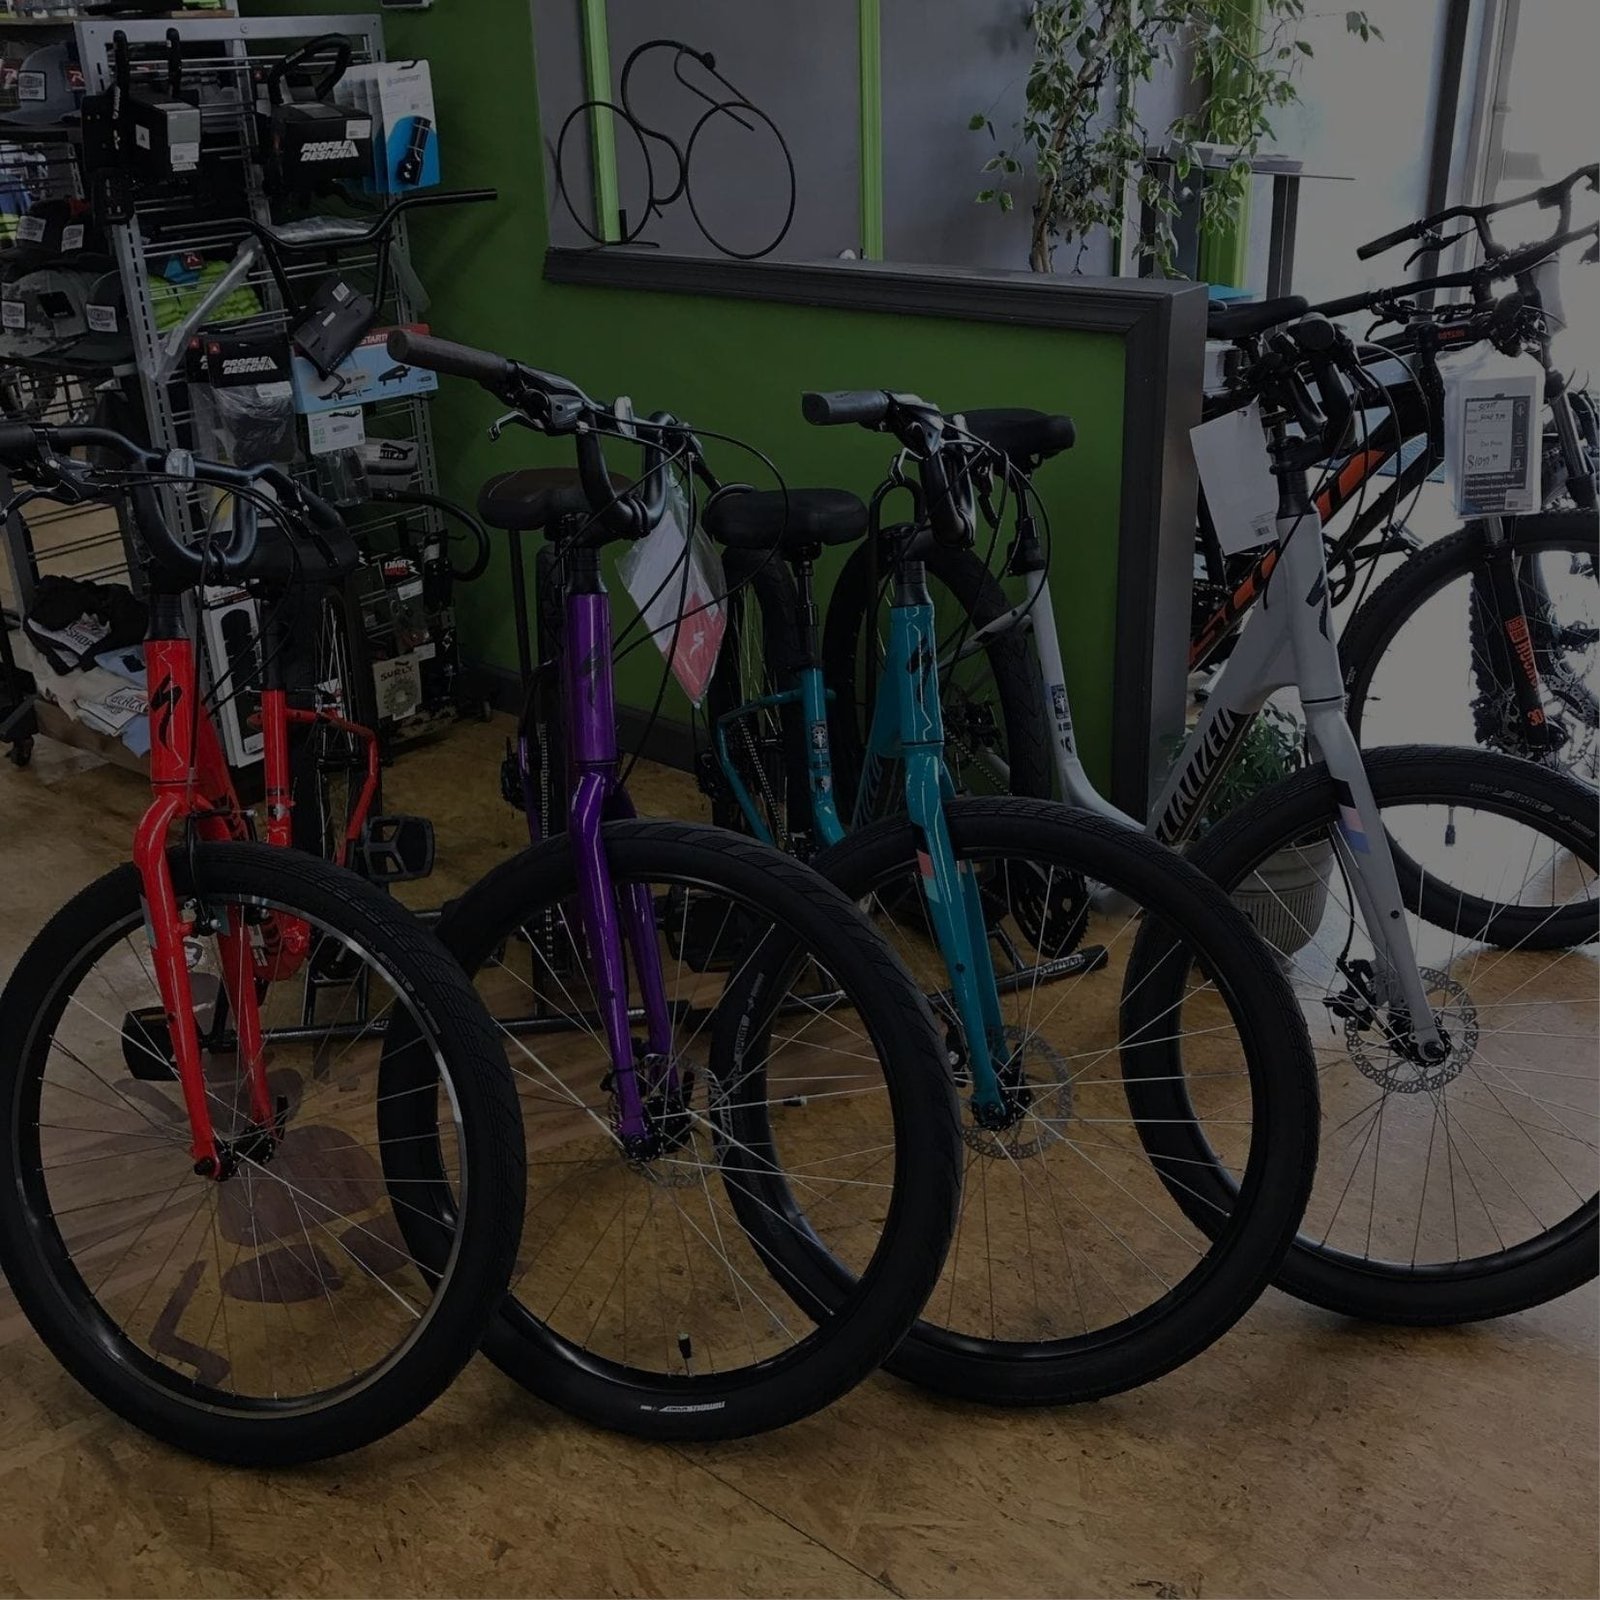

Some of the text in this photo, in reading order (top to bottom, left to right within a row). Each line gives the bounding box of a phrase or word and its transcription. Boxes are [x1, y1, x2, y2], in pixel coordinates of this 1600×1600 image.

[300, 140, 351, 153] PROFILE
[300, 149, 350, 161] DESIGN
[222, 355, 269, 369] PROFILE
[222, 363, 271, 375] DESIGN
[380, 664, 413, 682] SURLY
